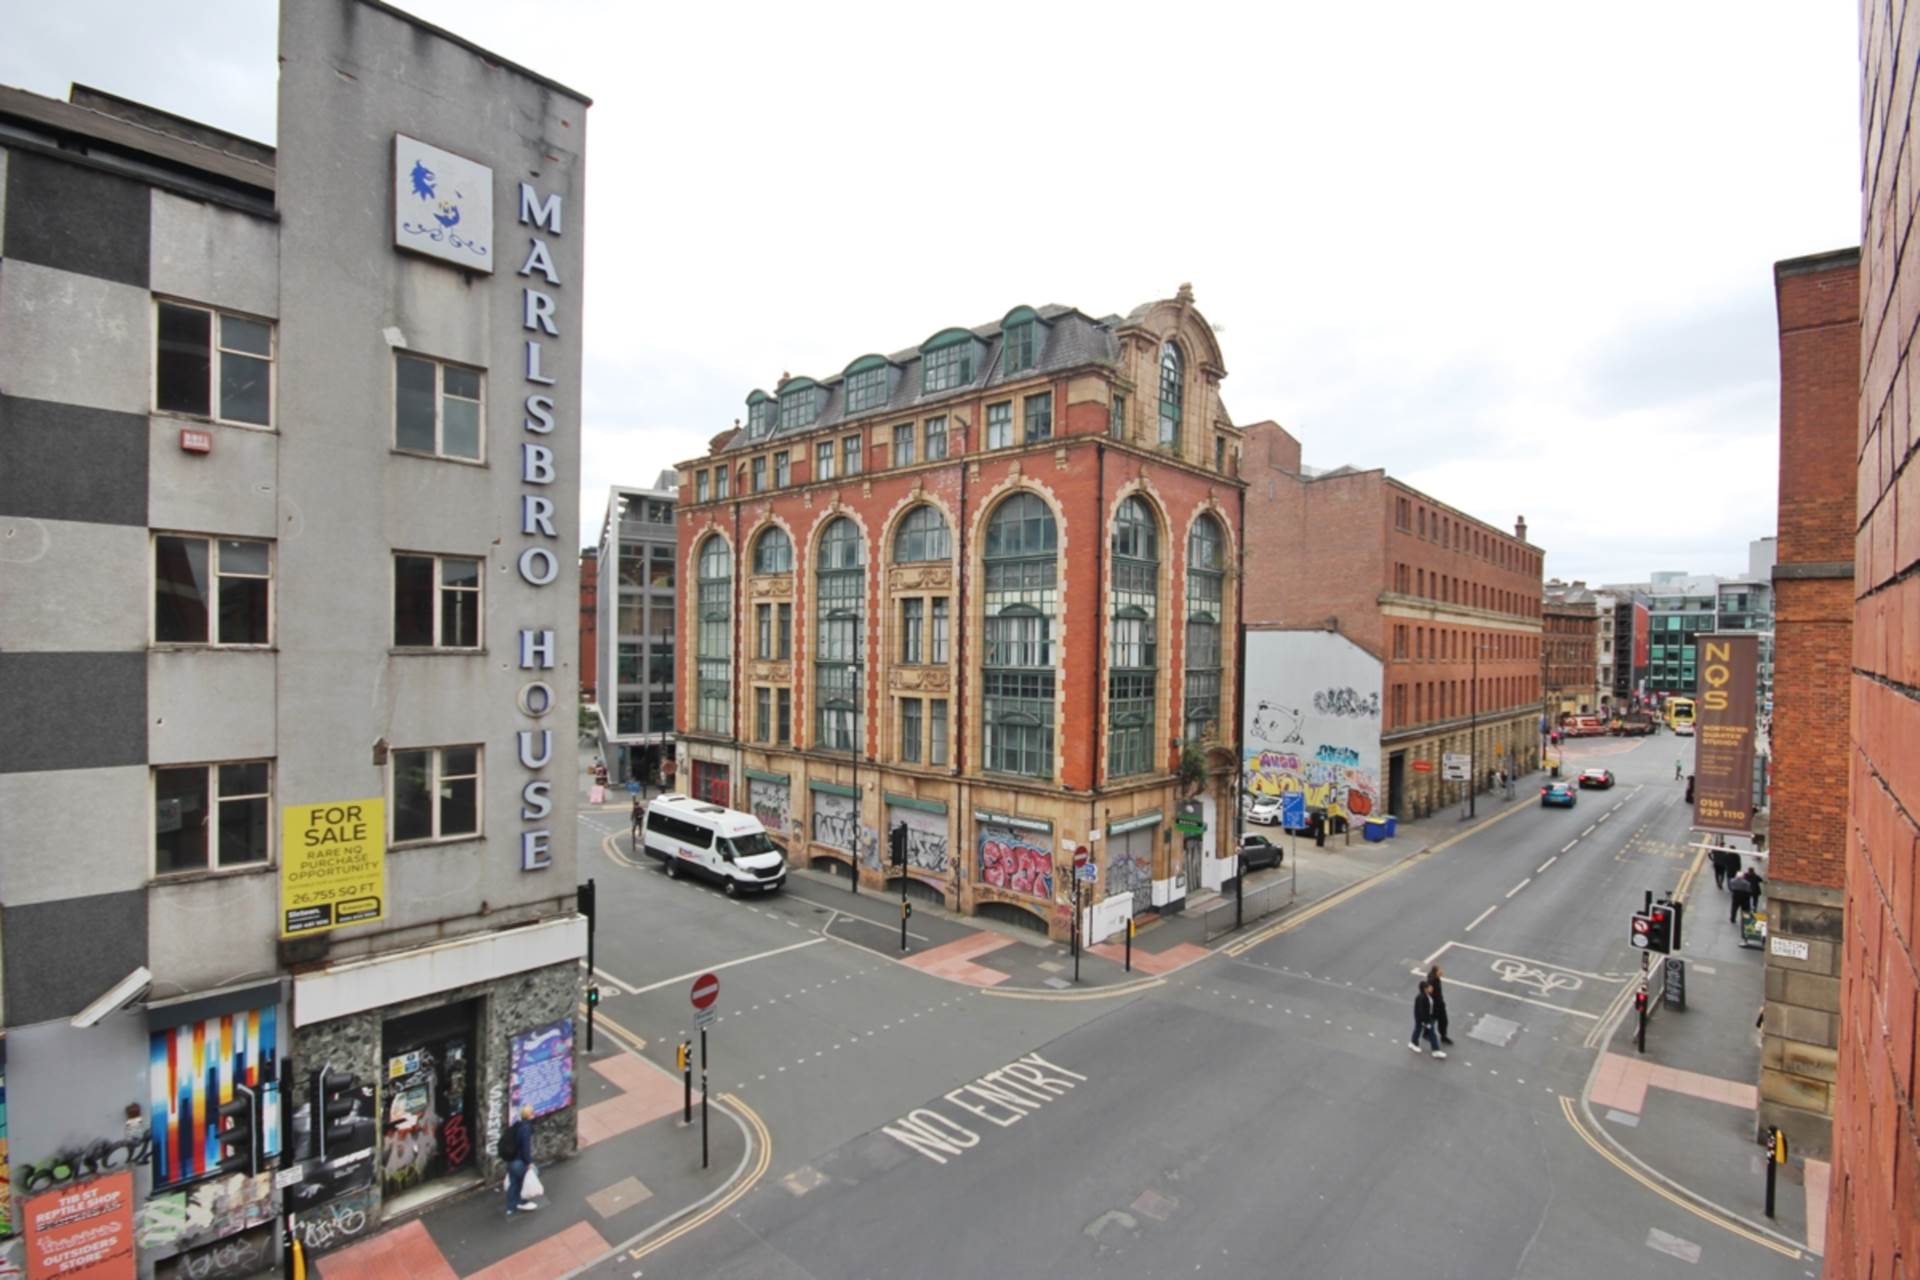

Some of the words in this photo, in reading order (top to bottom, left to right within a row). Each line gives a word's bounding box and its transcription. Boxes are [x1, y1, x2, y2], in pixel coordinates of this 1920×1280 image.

[517, 182, 563, 586] MARLSBRO
[1704, 642, 1731, 712] NQS
[517, 629, 556, 872] HOUSE
[1699, 798, 1724, 809] 0161
[1699, 807, 1721, 817] 929
[1723, 810, 1745, 820] 1110
[310, 805, 363, 827] FOR
[304, 823, 368, 847] SALE
[300, 853, 368, 870] PURCHASE
[307, 847, 341, 860] RARE
[288, 861, 379, 881] OPPORTUNITY
[338, 885, 358, 897] SQ
[360, 882, 375, 892] FT
[882, 1108, 981, 1164] NO
[944, 1052, 1088, 1127] ENTRY
[82, 1188, 99, 1201] ST
[36, 1201, 88, 1223] REPTILE
[87, 1191, 121, 1209] SHOP
[43, 1236, 118, 1266] OUTSIDERS
[59, 1252, 103, 1272] STORE
